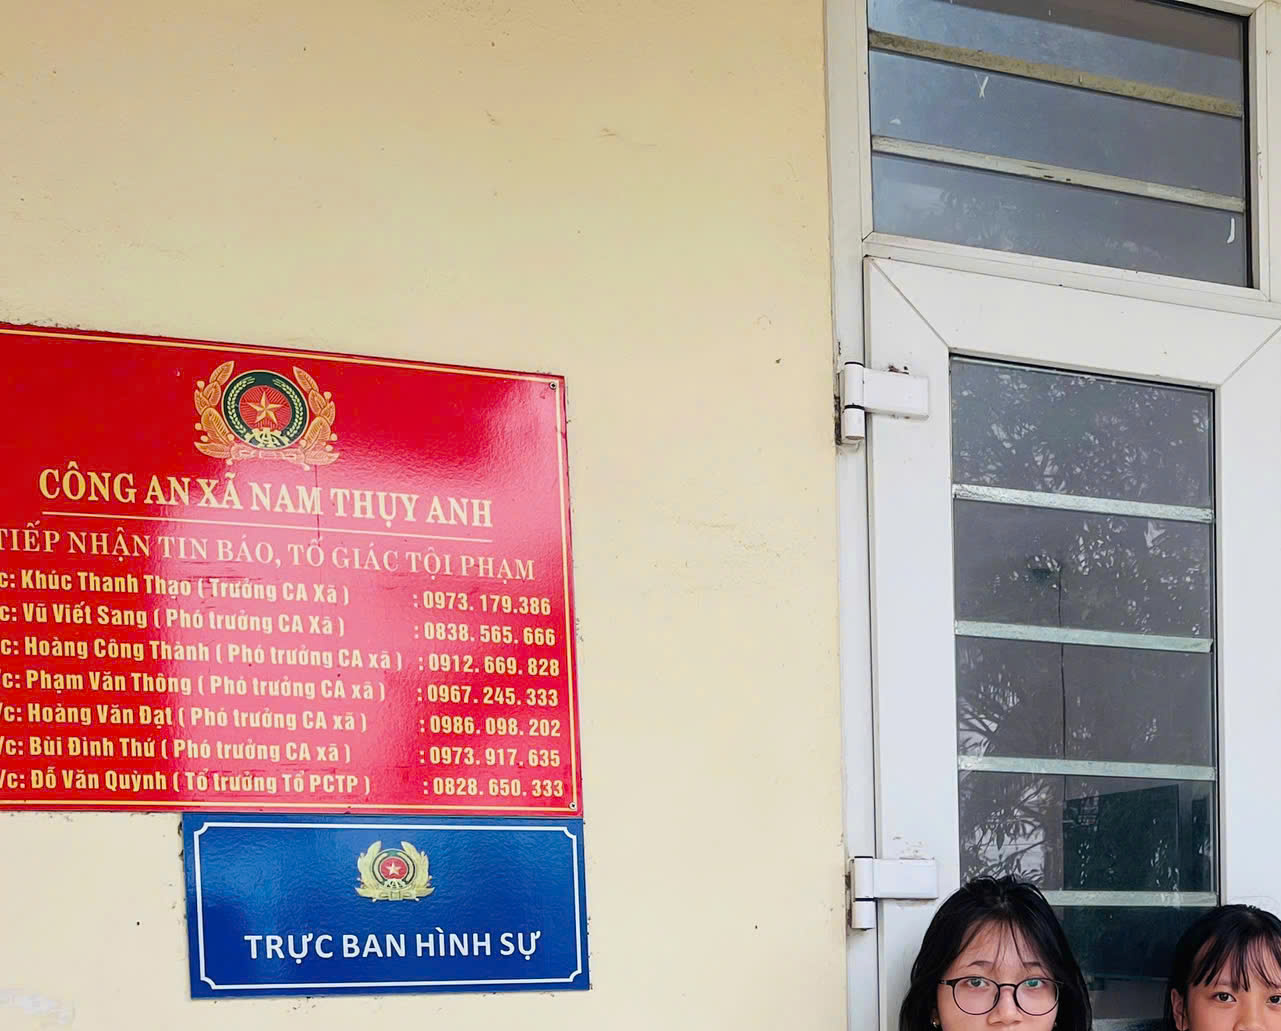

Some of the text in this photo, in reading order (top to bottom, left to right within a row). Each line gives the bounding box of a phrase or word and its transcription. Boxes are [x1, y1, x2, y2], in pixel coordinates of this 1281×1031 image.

[39, 460, 493, 528] CÔNG AN XÃ NAM THỤY ANH
[67, 527, 150, 562] NHẬN
[158, 535, 208, 560] TIN
[216, 533, 281, 568] BÁO,
[288, 536, 324, 567] TỐ
[331, 541, 400, 571] GIÁC
[406, 547, 452, 580] TỘI
[459, 555, 535, 584] PHẠM
[21, 569, 72, 591] Khúc
[77, 571, 139, 593] Thanh
[143, 575, 192, 599] Thạo
[208, 577, 277, 602] Trưởng
[282, 582, 308, 601] CA
[314, 583, 337, 603] Xã
[423, 590, 474, 612] 0973.
[22, 602, 47, 623] Vũ
[53, 601, 92, 625] Viết
[97, 605, 148, 629] Sang
[166, 608, 203, 629] Phó
[209, 609, 273, 634] trưởng
[278, 614, 303, 633] CA
[309, 616, 333, 635] Xã
[424, 622, 475, 642] 0838.
[480, 624, 518, 644] 565.
[523, 627, 556, 646] 666
[24, 636, 89, 659] Hoàng
[94, 638, 144, 662] Công
[150, 640, 209, 662] Thành
[228, 644, 265, 664] Phó
[270, 645, 333, 668] trưởng
[338, 648, 363, 668] CA
[368, 653, 391, 669] xã
[428, 653, 480, 672] 0912.
[484, 656, 523, 675] 669.
[528, 658, 560, 676] 828
[26, 669, 84, 694] Phạm
[89, 671, 126, 691] Văn
[131, 672, 192, 695] Thông
[210, 676, 247, 695] Phó
[253, 676, 315, 700] trưởng
[320, 679, 345, 698] CA
[352, 682, 374, 700] xã
[427, 684, 478, 703] 0967.
[483, 687, 522, 705] 245.
[526, 688, 558, 706] 333
[27, 702, 91, 725] Hoàng
[97, 704, 134, 724] Văn
[139, 705, 173, 729] Đạt
[190, 707, 228, 727] Phó
[234, 708, 297, 731] trưởng
[302, 711, 327, 730] CA
[333, 714, 355, 730] xã
[430, 716, 481, 734] 0986.
[485, 718, 524, 736] 098.
[529, 719, 560, 737] 202
[29, 736, 62, 756] Bùi
[67, 737, 114, 757] Đình
[120, 737, 156, 757] Thứ
[173, 738, 211, 759] Phó
[216, 739, 280, 762] trưởng
[285, 741, 311, 761] CA
[317, 745, 339, 761] xã
[430, 746, 480, 766] 0973.
[485, 750, 523, 766] 917.
[528, 750, 560, 767] 635
[31, 766, 57, 789] Đỗ
[62, 769, 99, 790] Văn
[105, 770, 167, 792] Quỳnh
[185, 768, 208, 791] Tổ
[214, 773, 277, 794] trưởng
[282, 771, 305, 792] Tổ
[310, 774, 359, 793] PCTP
[433, 778, 484, 796] 0828.
[488, 779, 527, 796] 650.
[532, 780, 564, 797] 333
[244, 926, 541, 965] TRỰC BAN HÌNH SỰ
